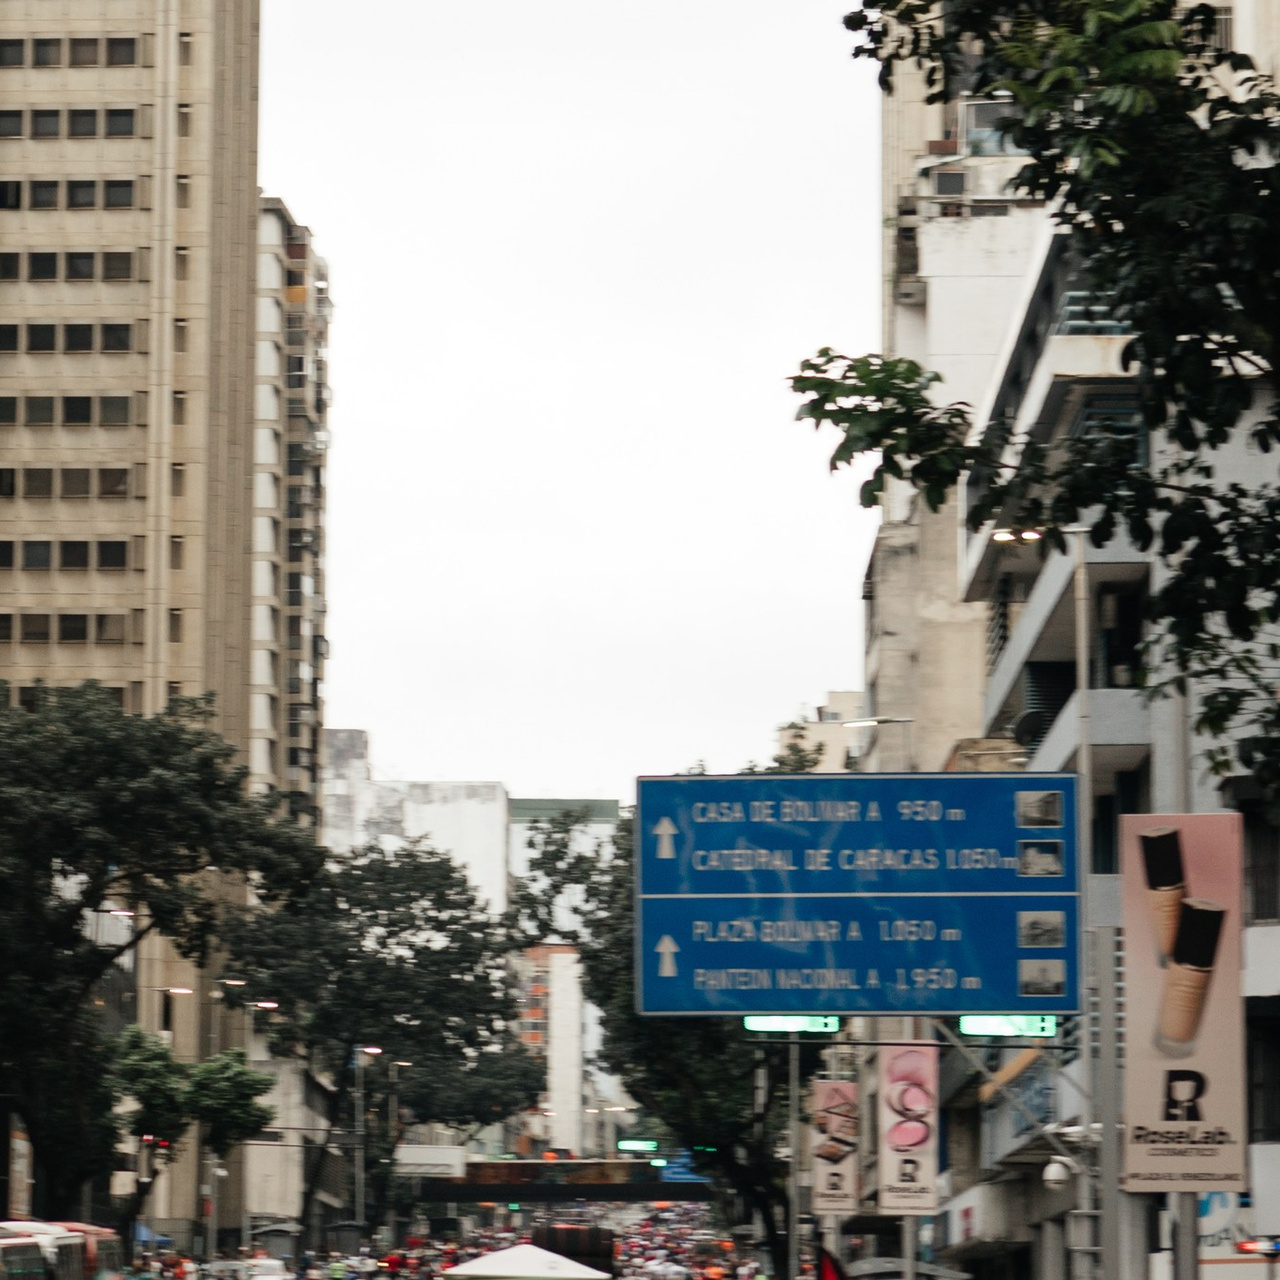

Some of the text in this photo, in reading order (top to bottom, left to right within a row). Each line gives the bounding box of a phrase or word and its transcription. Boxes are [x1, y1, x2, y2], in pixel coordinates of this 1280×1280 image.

[691, 800, 966, 822] CASA DE BOLIVAR A 950 m
[691, 849, 798, 871] CATEDRAL
[804, 849, 833, 871] DE
[838, 848, 940, 870] CARACAS
[692, 920, 756, 942] PLAZA
[759, 920, 842, 942] BOLIVAR
[846, 920, 863, 941] A
[940, 928, 962, 941] m
[693, 968, 771, 990] PANTEON
[775, 968, 862, 990] NACIONAL
[865, 968, 881, 989] A
[961, 976, 982, 989] m
